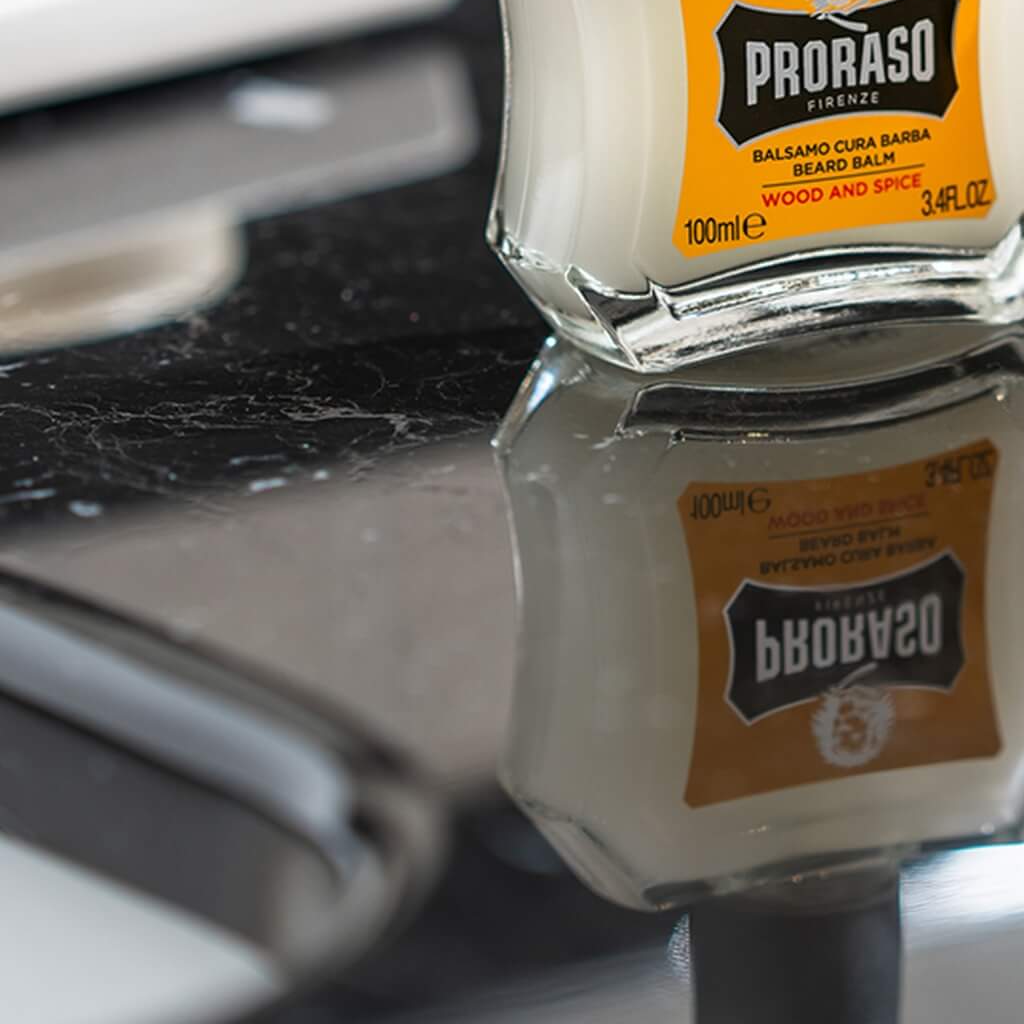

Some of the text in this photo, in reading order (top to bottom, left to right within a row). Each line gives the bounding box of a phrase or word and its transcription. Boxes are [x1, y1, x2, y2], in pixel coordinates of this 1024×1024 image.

[745, 18, 935, 106] PRORASO
[807, 91, 880, 112] FIRENZE
[753, 127, 932, 163] BALSAMO CURA BARBA
[793, 152, 896, 177] BEARD BALM
[761, 172, 922, 208] WOOD AND SPICE
